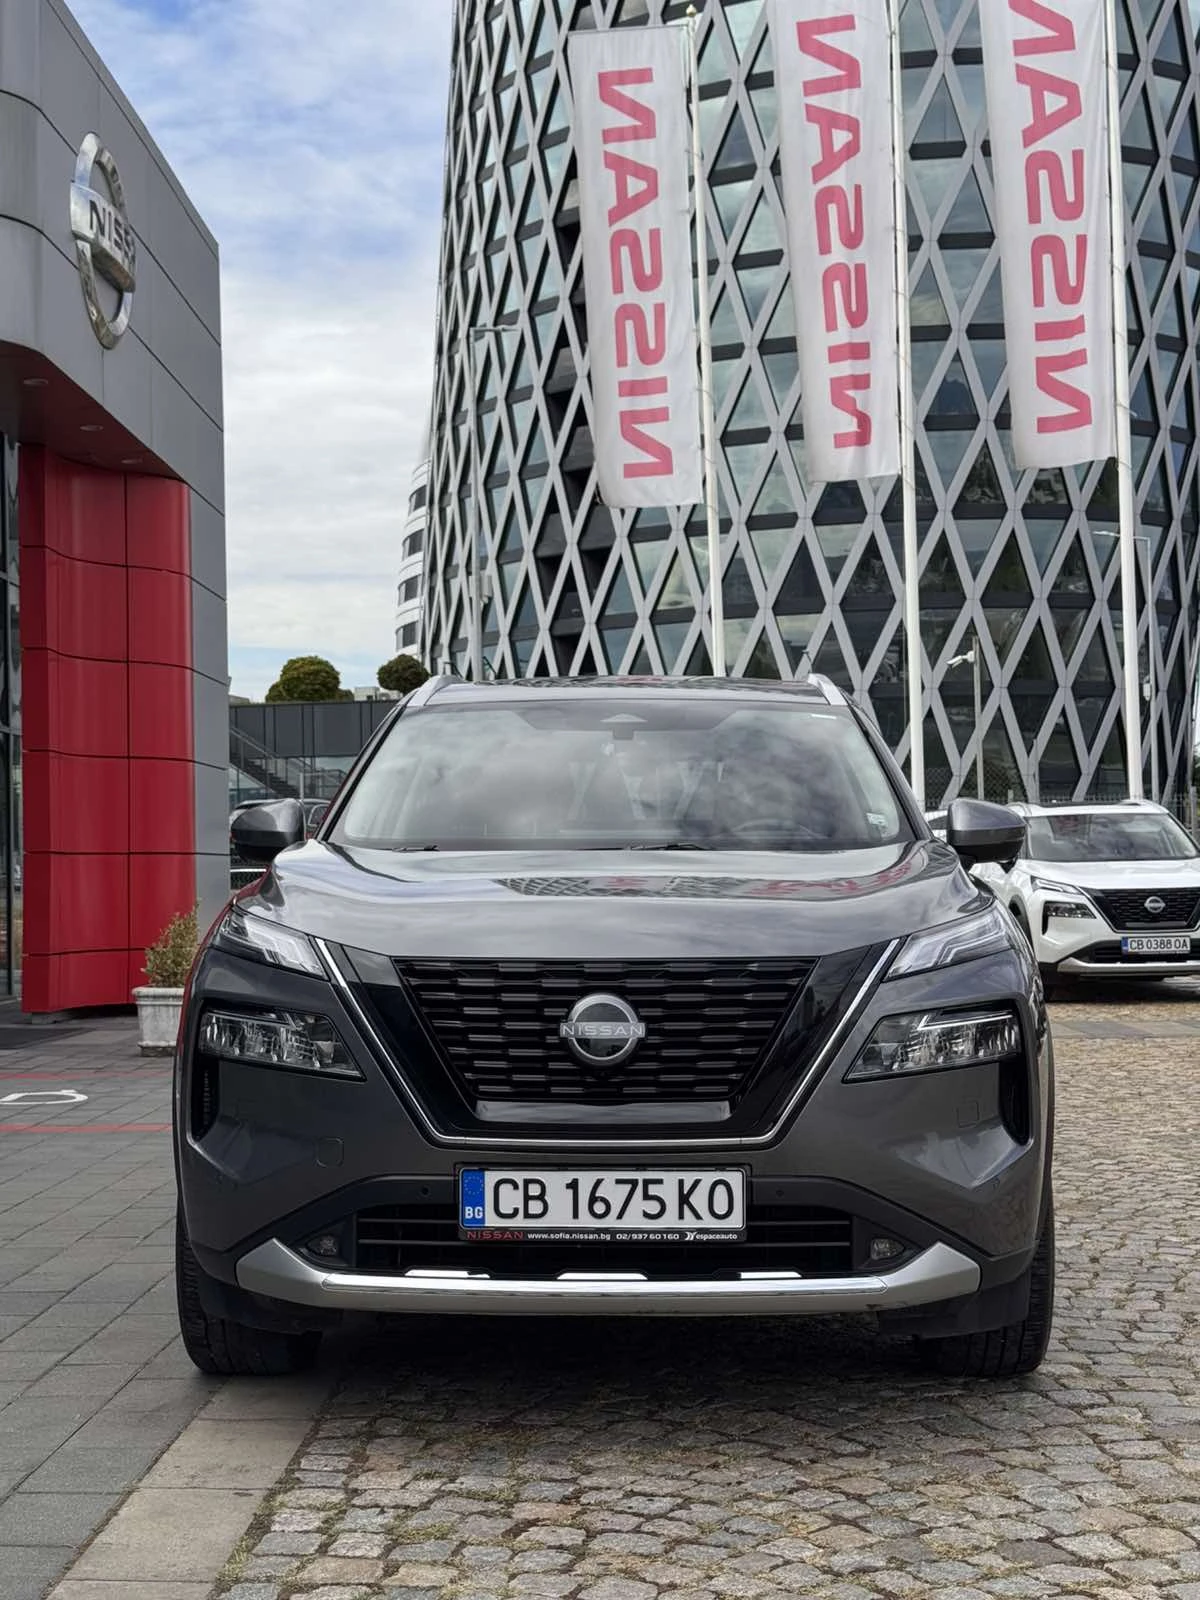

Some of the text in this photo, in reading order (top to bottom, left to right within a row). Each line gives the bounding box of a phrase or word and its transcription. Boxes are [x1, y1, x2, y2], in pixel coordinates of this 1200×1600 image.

[1129, 939, 1189, 950] CB 0388 OA
[562, 1025, 642, 1036] NISSAN
[493, 1178, 735, 1220] CB 1675 KO
[464, 1206, 483, 1219] BG
[466, 1231, 525, 1240] NISSAN
[527, 1232, 611, 1241] www.sofia.nissan.bg
[695, 1233, 738, 1241] espaceauto
